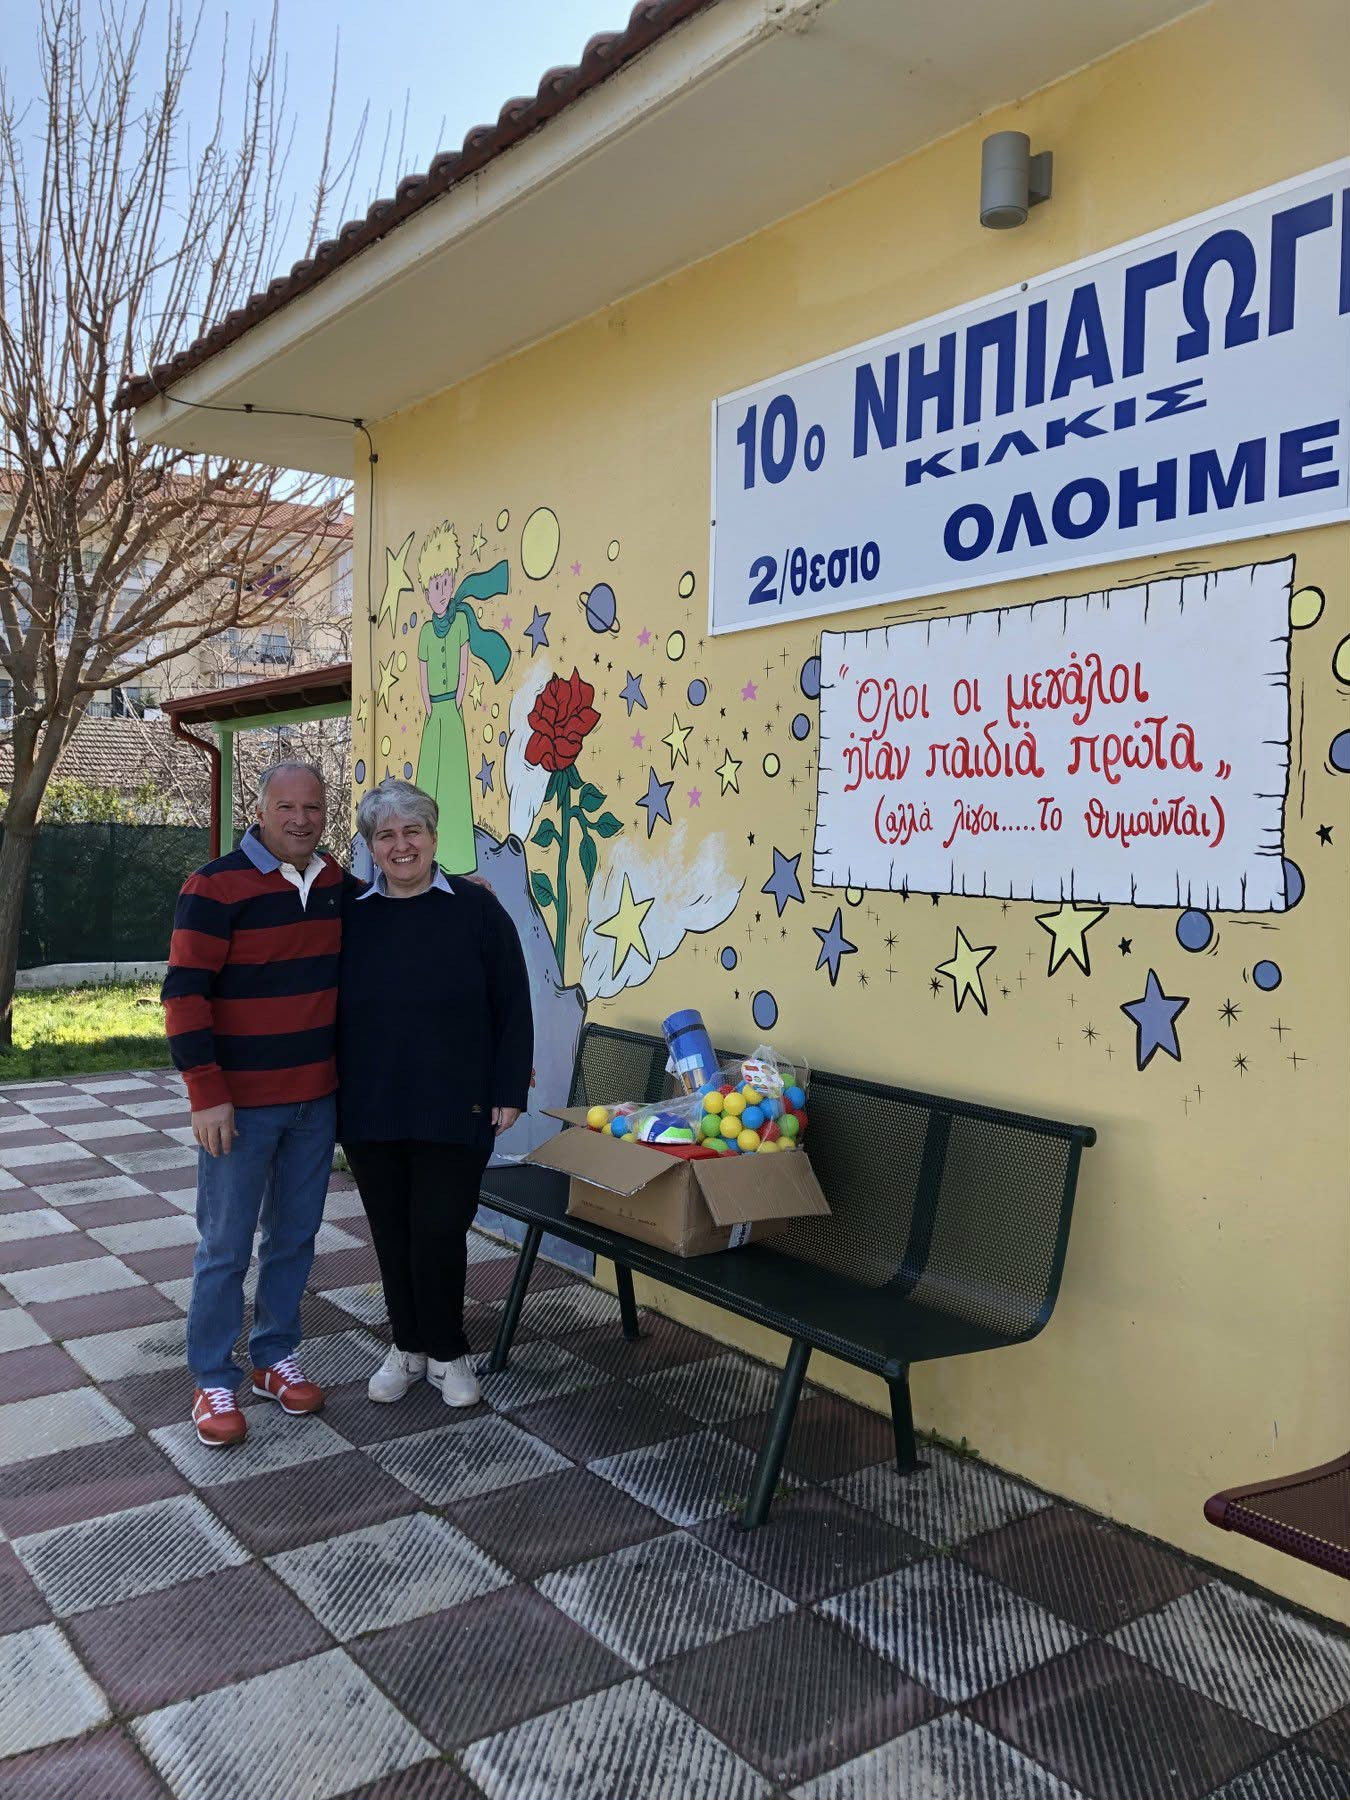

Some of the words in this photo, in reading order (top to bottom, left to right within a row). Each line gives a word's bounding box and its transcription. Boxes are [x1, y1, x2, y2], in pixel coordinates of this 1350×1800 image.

[853, 187, 1350, 459] ΝΗΠΙΑΓΩΓ
[905, 377, 1207, 487] ΚΙΛΚΙΣ
[748, 540, 881, 605] 2/θεσιο
[943, 418, 1340, 562] ΟΛΟΗΜΕ
[953, 678, 982, 717] οι
[1006, 651, 1150, 729] μεγάλοι
[842, 732, 911, 793] ήταν
[925, 719, 1046, 779] παιδιά
[874, 794, 933, 846] (αλλά
[1083, 795, 1226, 849] θυμούνται)
